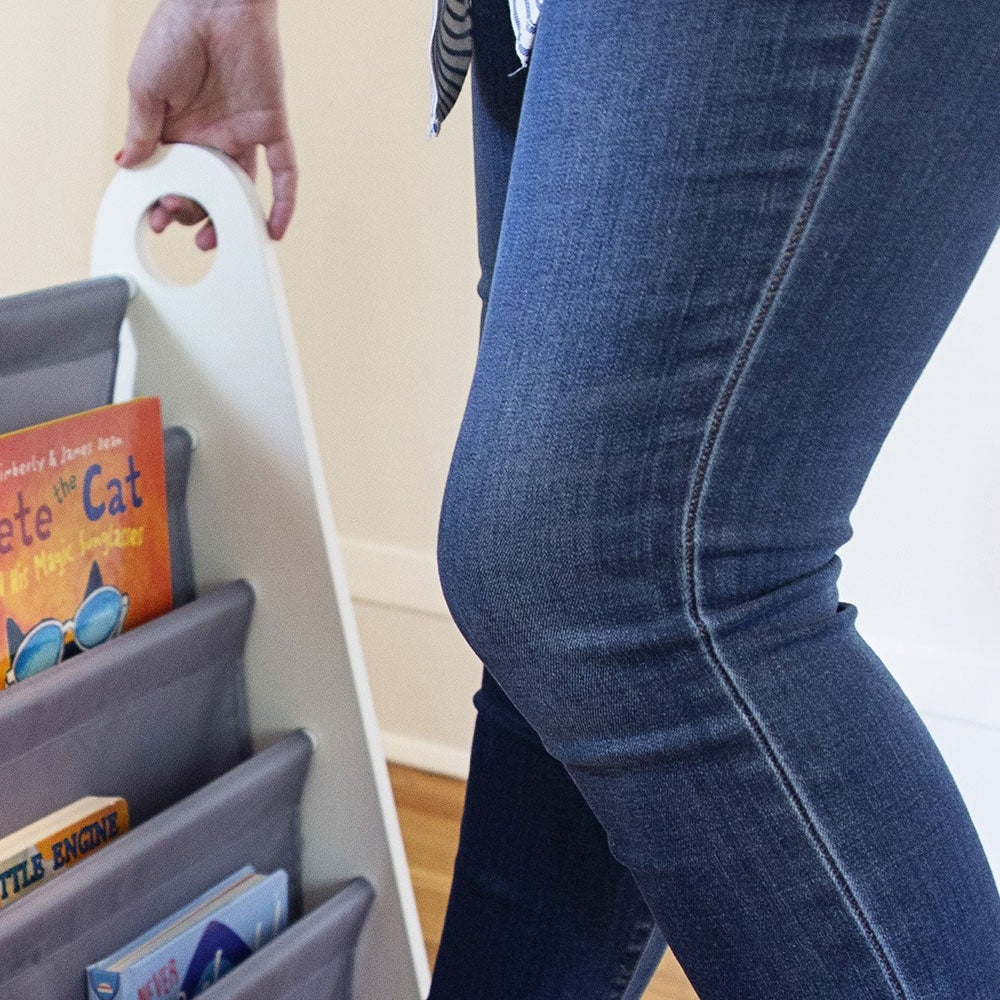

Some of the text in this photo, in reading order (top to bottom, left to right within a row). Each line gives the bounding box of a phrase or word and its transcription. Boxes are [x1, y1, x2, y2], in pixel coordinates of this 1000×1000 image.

[52, 474, 77, 504] the
[82, 455, 143, 521] Cat
[51, 811, 119, 872] ENGINE
